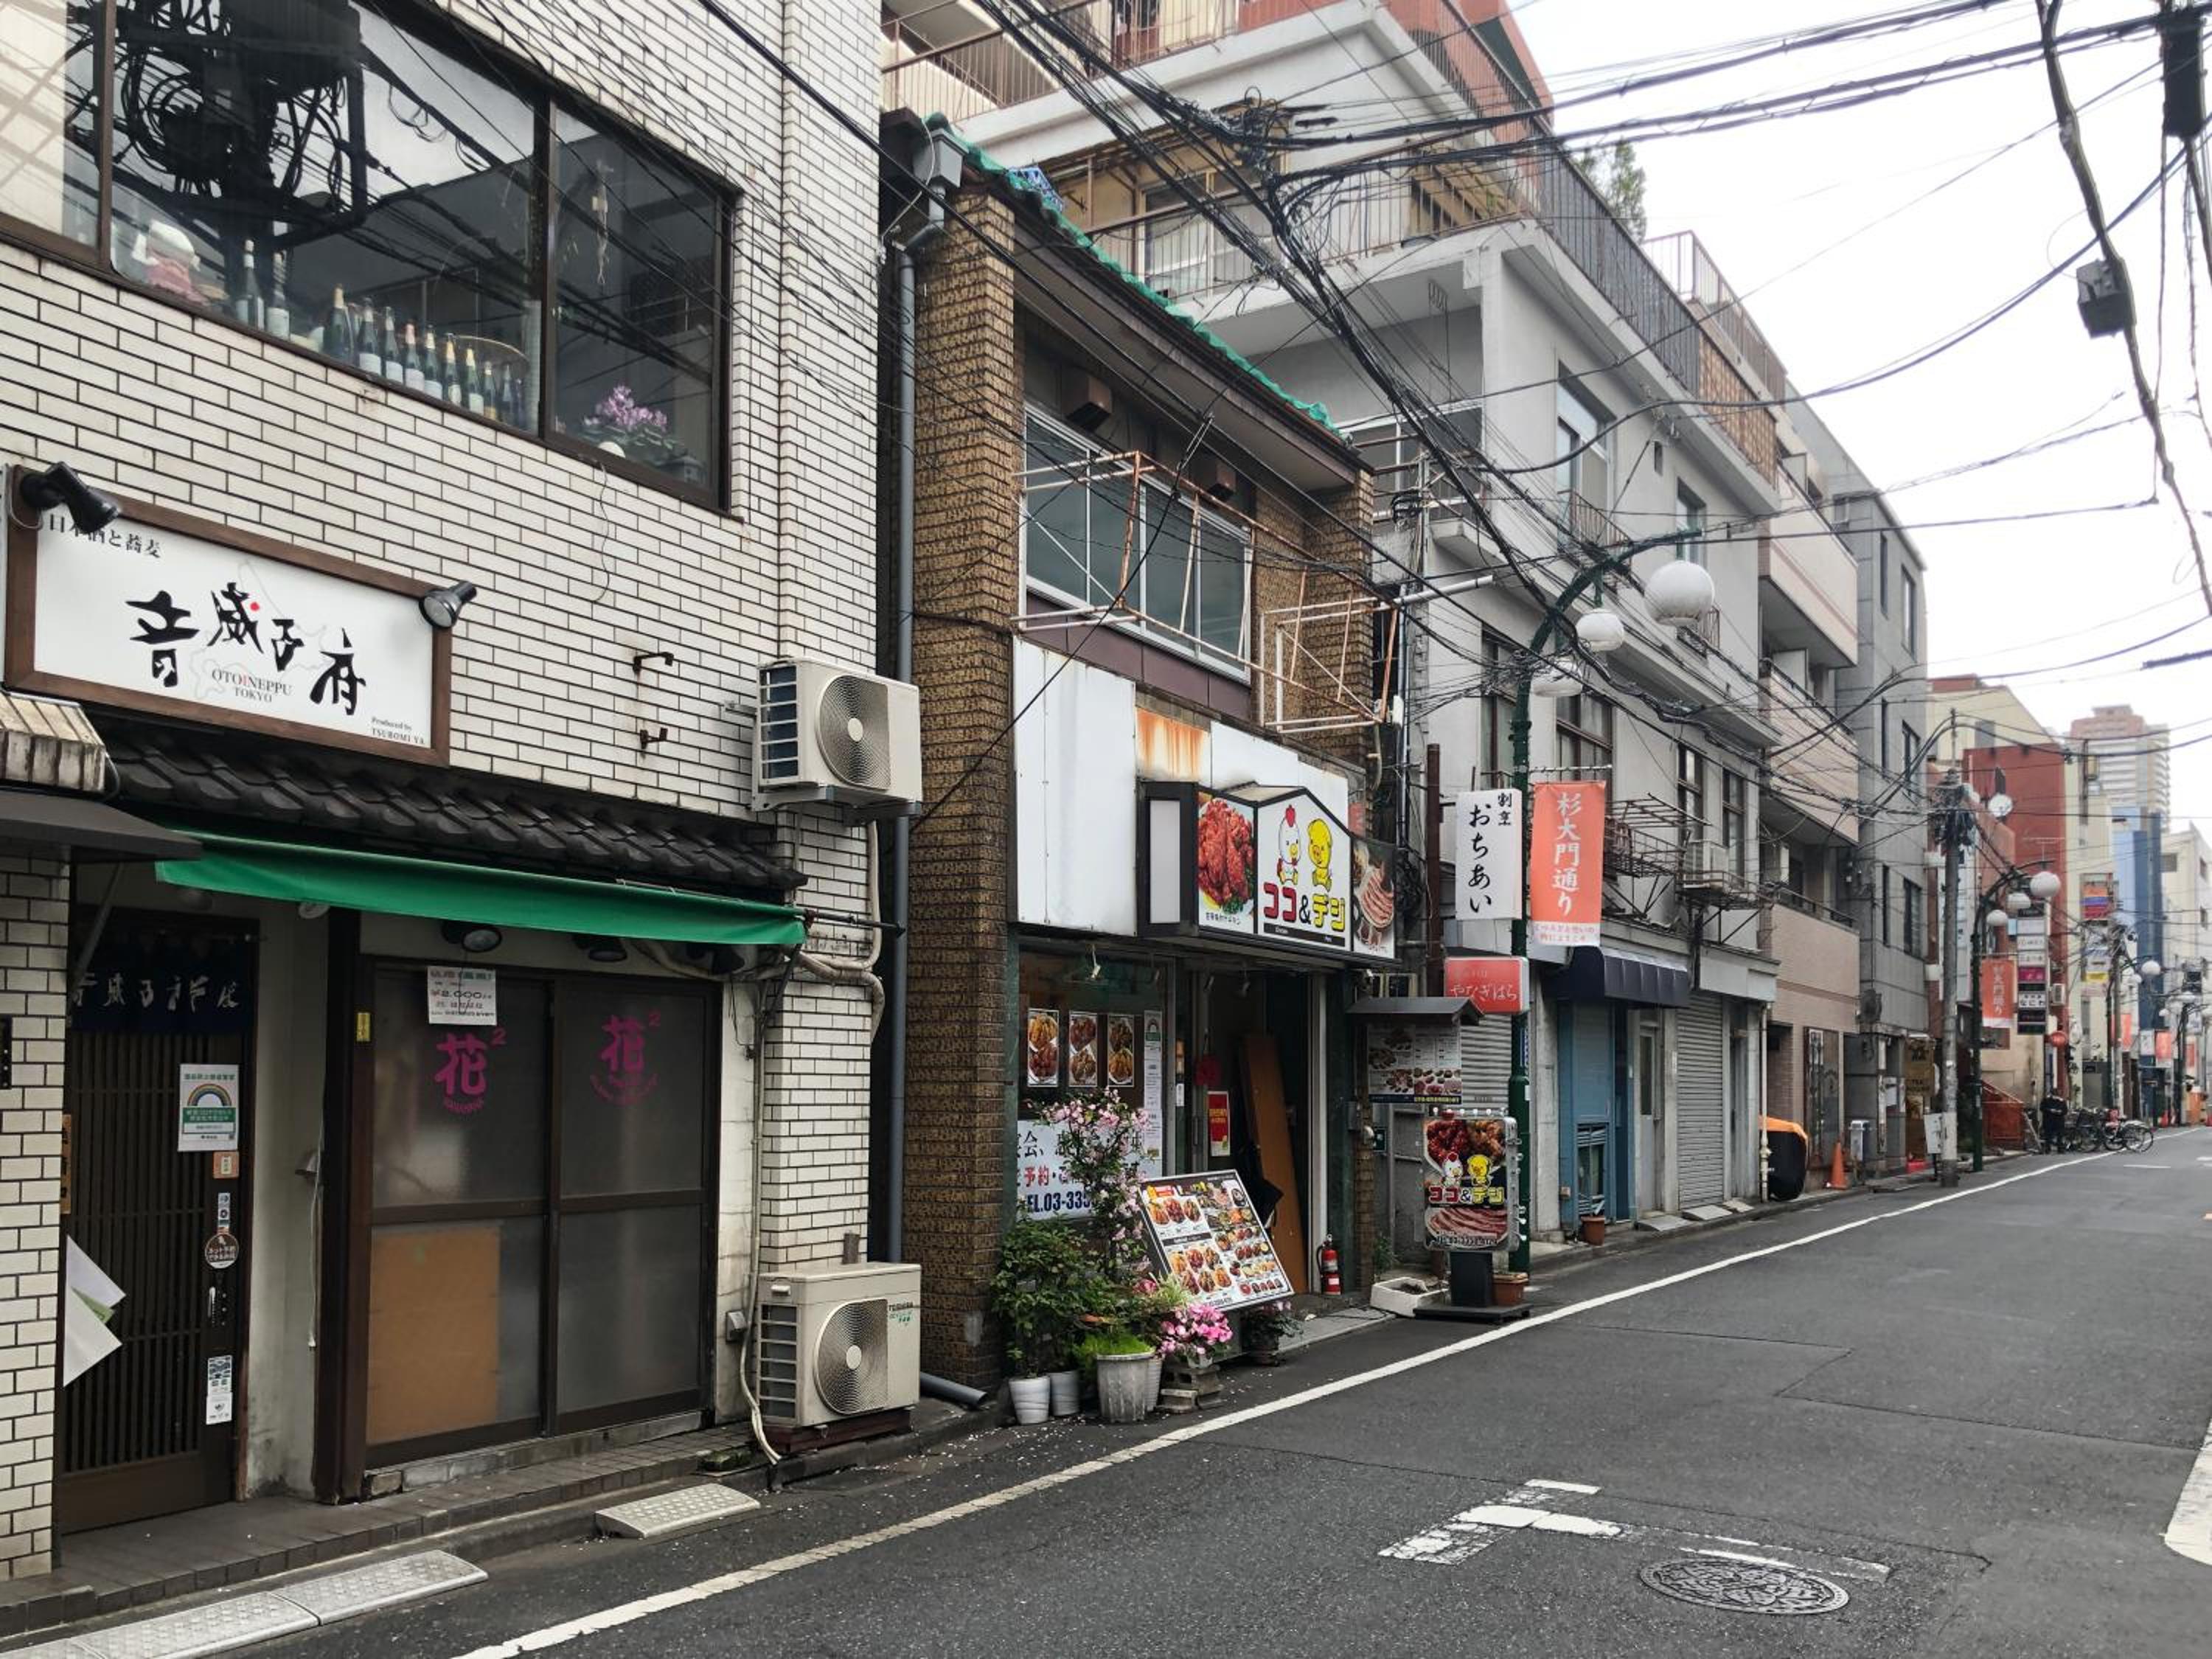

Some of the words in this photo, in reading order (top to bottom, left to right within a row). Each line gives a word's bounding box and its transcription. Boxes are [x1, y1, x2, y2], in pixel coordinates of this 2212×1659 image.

[212, 669, 293, 696] OTOINEPPU
[234, 686, 273, 703] TOKYO
[1498, 793, 1512, 826] 割烹
[1468, 804, 1492, 913] おちあい
[1552, 792, 1582, 917] 杉大門通り
